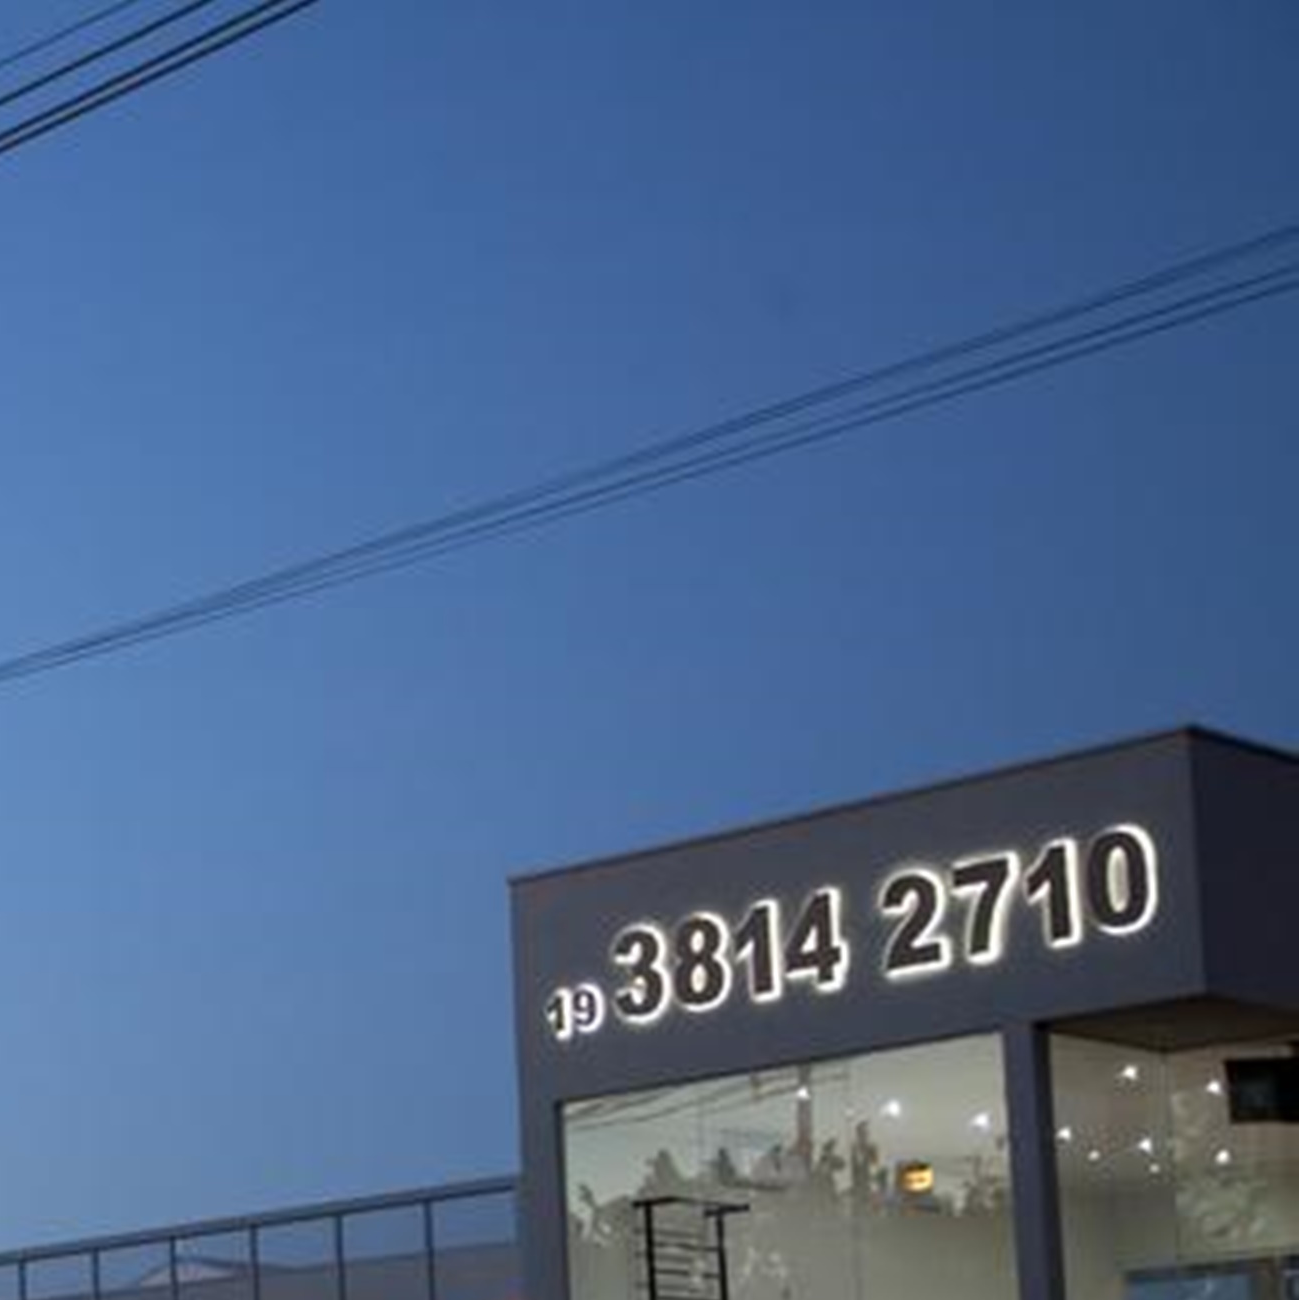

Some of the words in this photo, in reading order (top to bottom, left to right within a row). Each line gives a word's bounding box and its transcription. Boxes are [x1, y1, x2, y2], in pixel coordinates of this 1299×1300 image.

[547, 983, 601, 1039] 19
[614, 886, 848, 1021] 3814
[879, 824, 1156, 980] 2710
